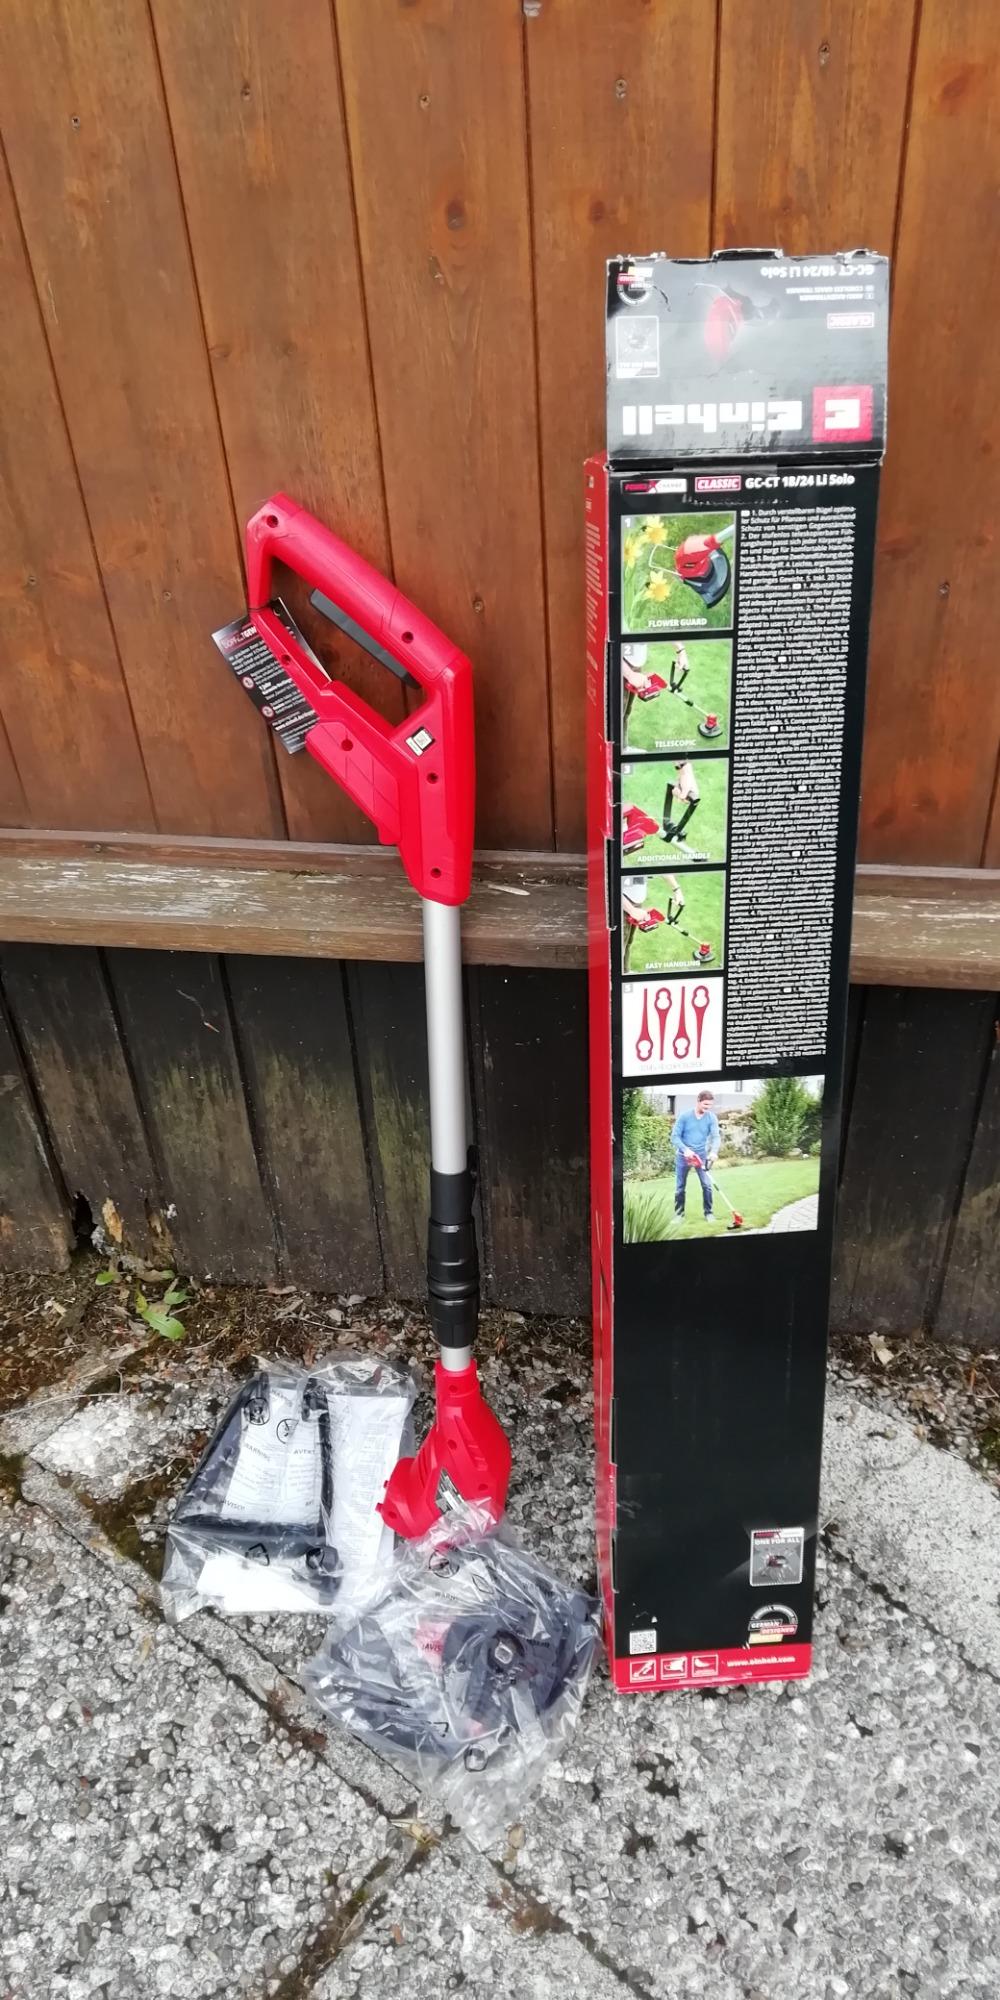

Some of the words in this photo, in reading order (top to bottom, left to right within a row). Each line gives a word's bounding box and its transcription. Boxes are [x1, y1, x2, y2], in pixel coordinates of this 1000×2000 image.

[761, 266, 787, 278] Solo
[790, 266, 800, 278] Li
[803, 266, 836, 277] 18/24
[622, 400, 802, 435] Einhell
[698, 478, 739, 490] CLASSIC
[745, 476, 780, 489] GC-CT
[782, 476, 814, 488] 18/24
[816, 474, 827, 486] Li
[829, 473, 855, 486] Solo
[624, 518, 631, 528] 1
[648, 620, 680, 628] FLOWER
[680, 618, 708, 626] GUARD
[624, 646, 631, 654] 2
[655, 740, 696, 748] TELESCOPIC
[638, 854, 680, 862] ADDITIONAL
[664, 960, 700, 968] HANDLING
